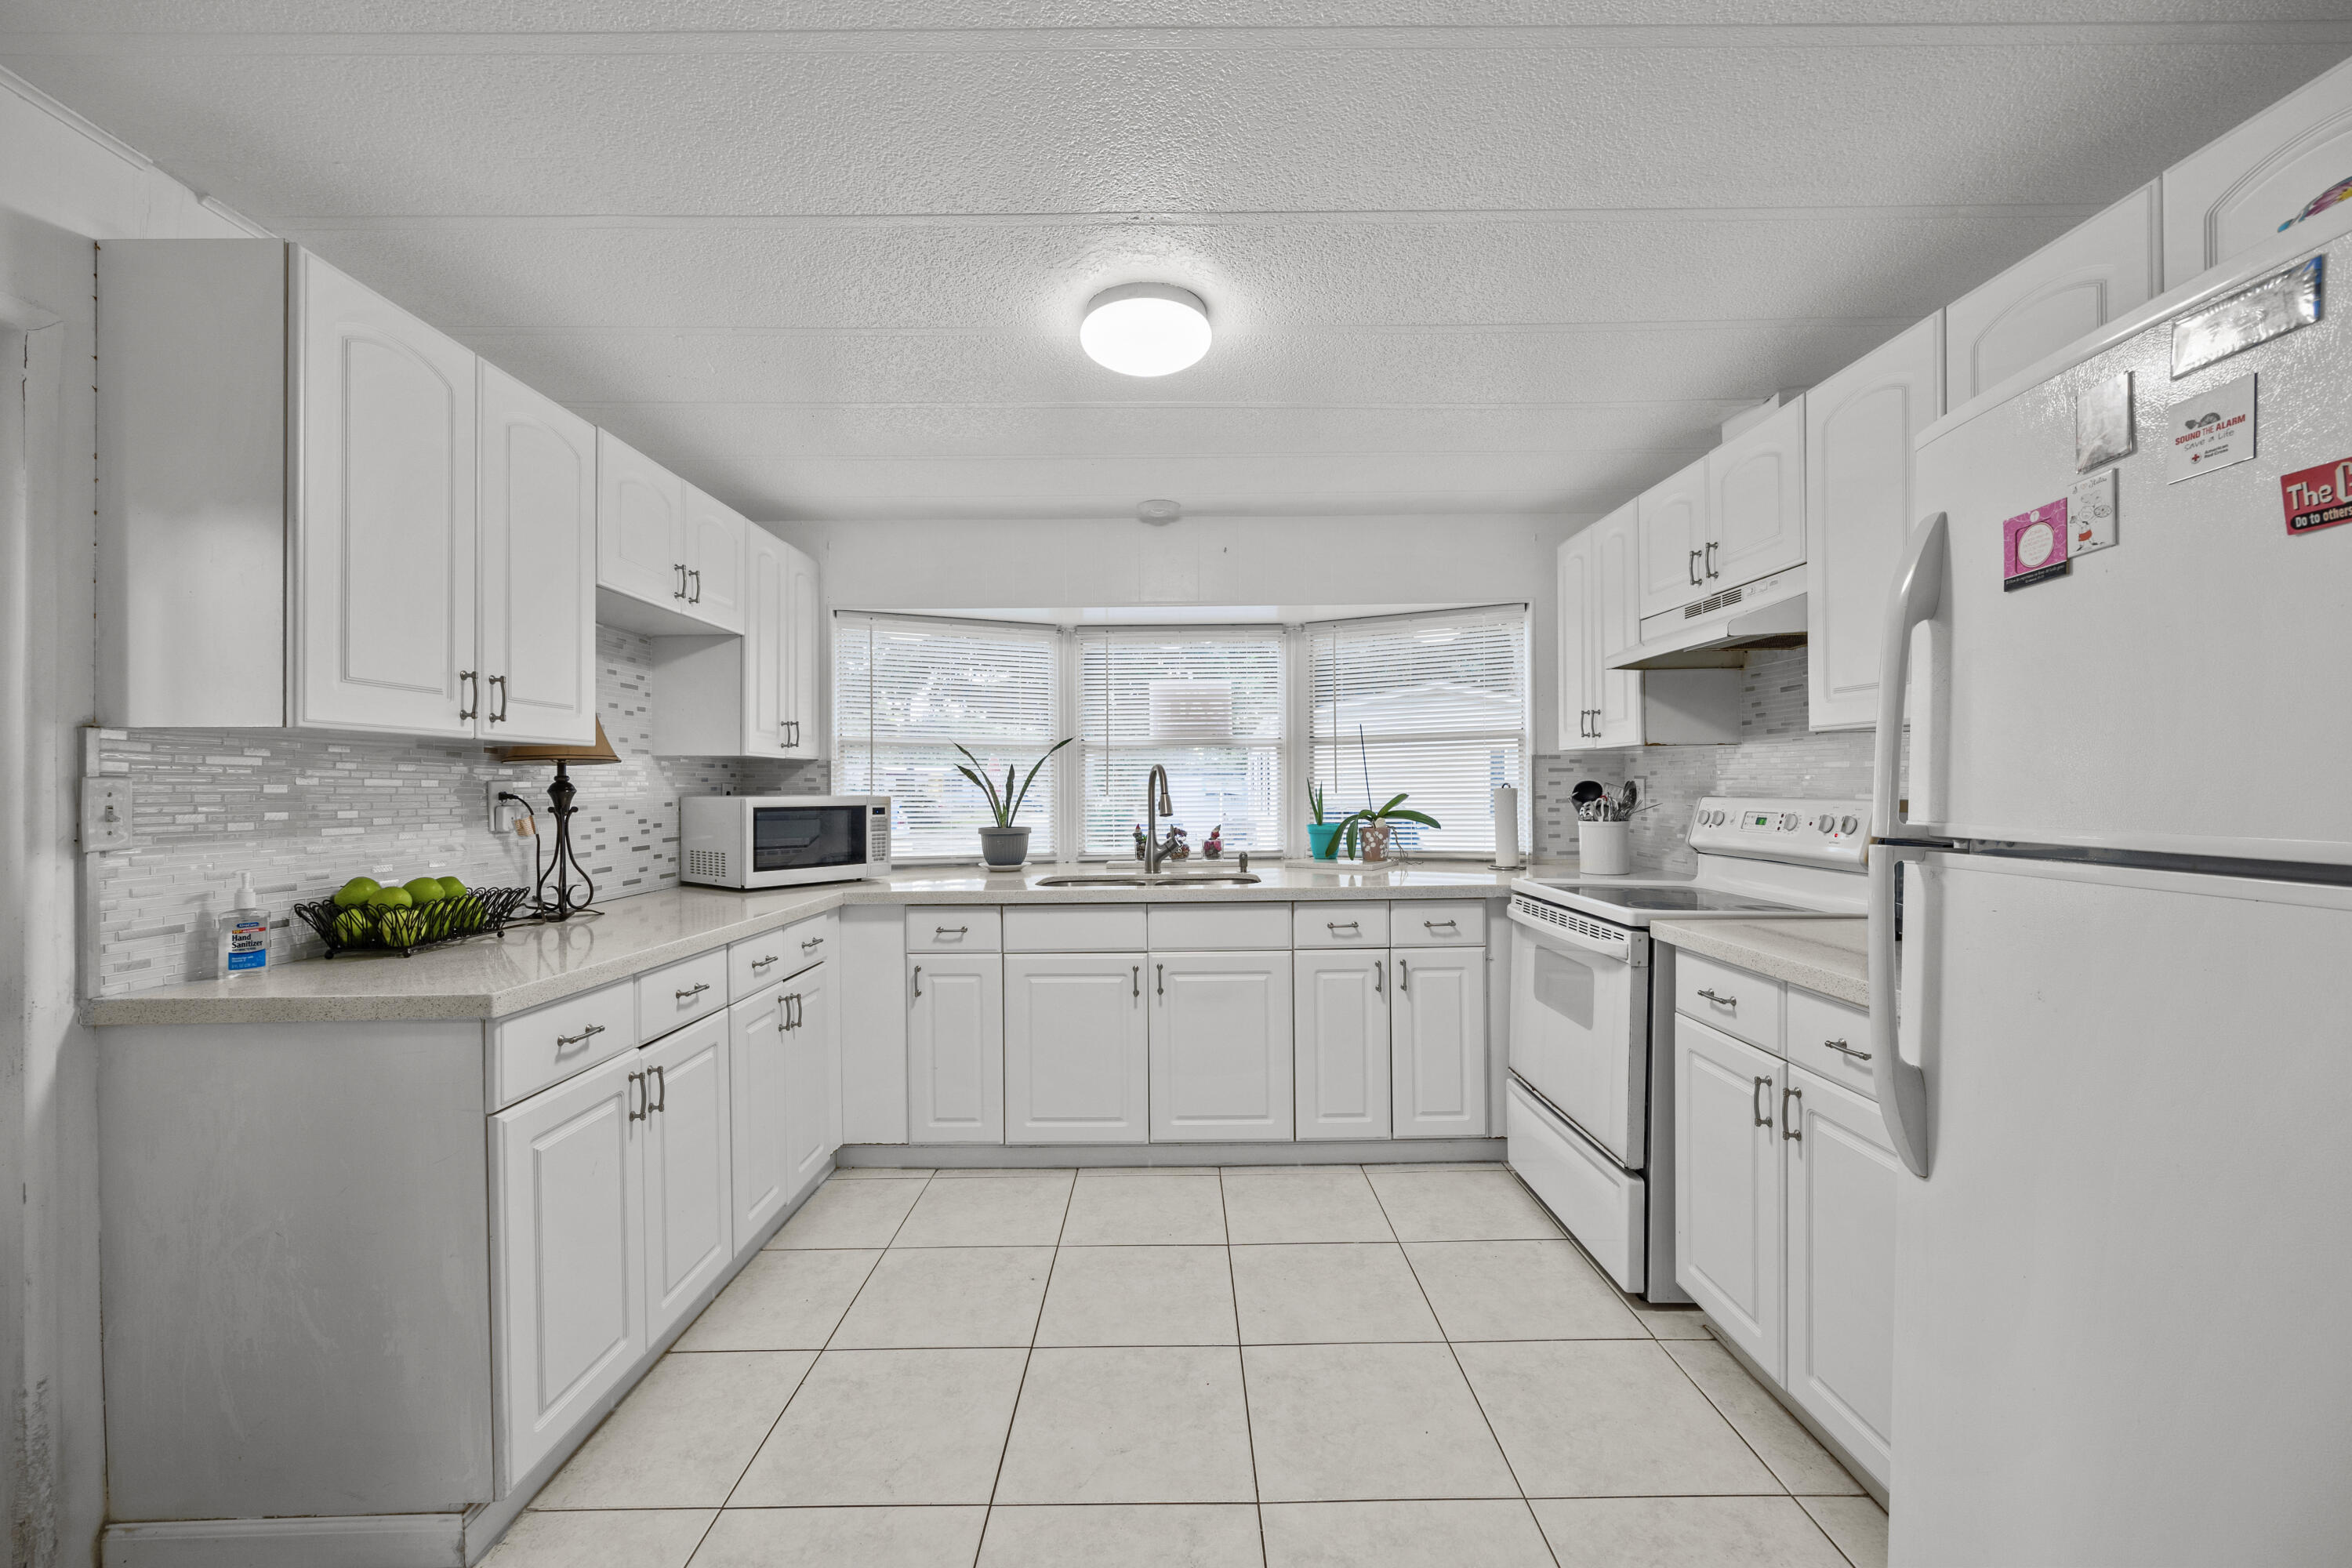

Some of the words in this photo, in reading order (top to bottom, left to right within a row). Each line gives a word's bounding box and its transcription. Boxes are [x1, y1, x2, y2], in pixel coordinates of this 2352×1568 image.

[2175, 430, 2201, 445] SOUND
[2202, 426, 2215, 436] THE
[2216, 414, 2246, 431] ALARM
[2218, 428, 2234, 440] Life
[2205, 444, 2229, 454] American
[2286, 481, 2333, 510] The
[2296, 517, 2307, 528] Do
[2310, 514, 2321, 524] to
[2323, 506, 2352, 521] others
[231, 940, 263, 949] Sanitizer
